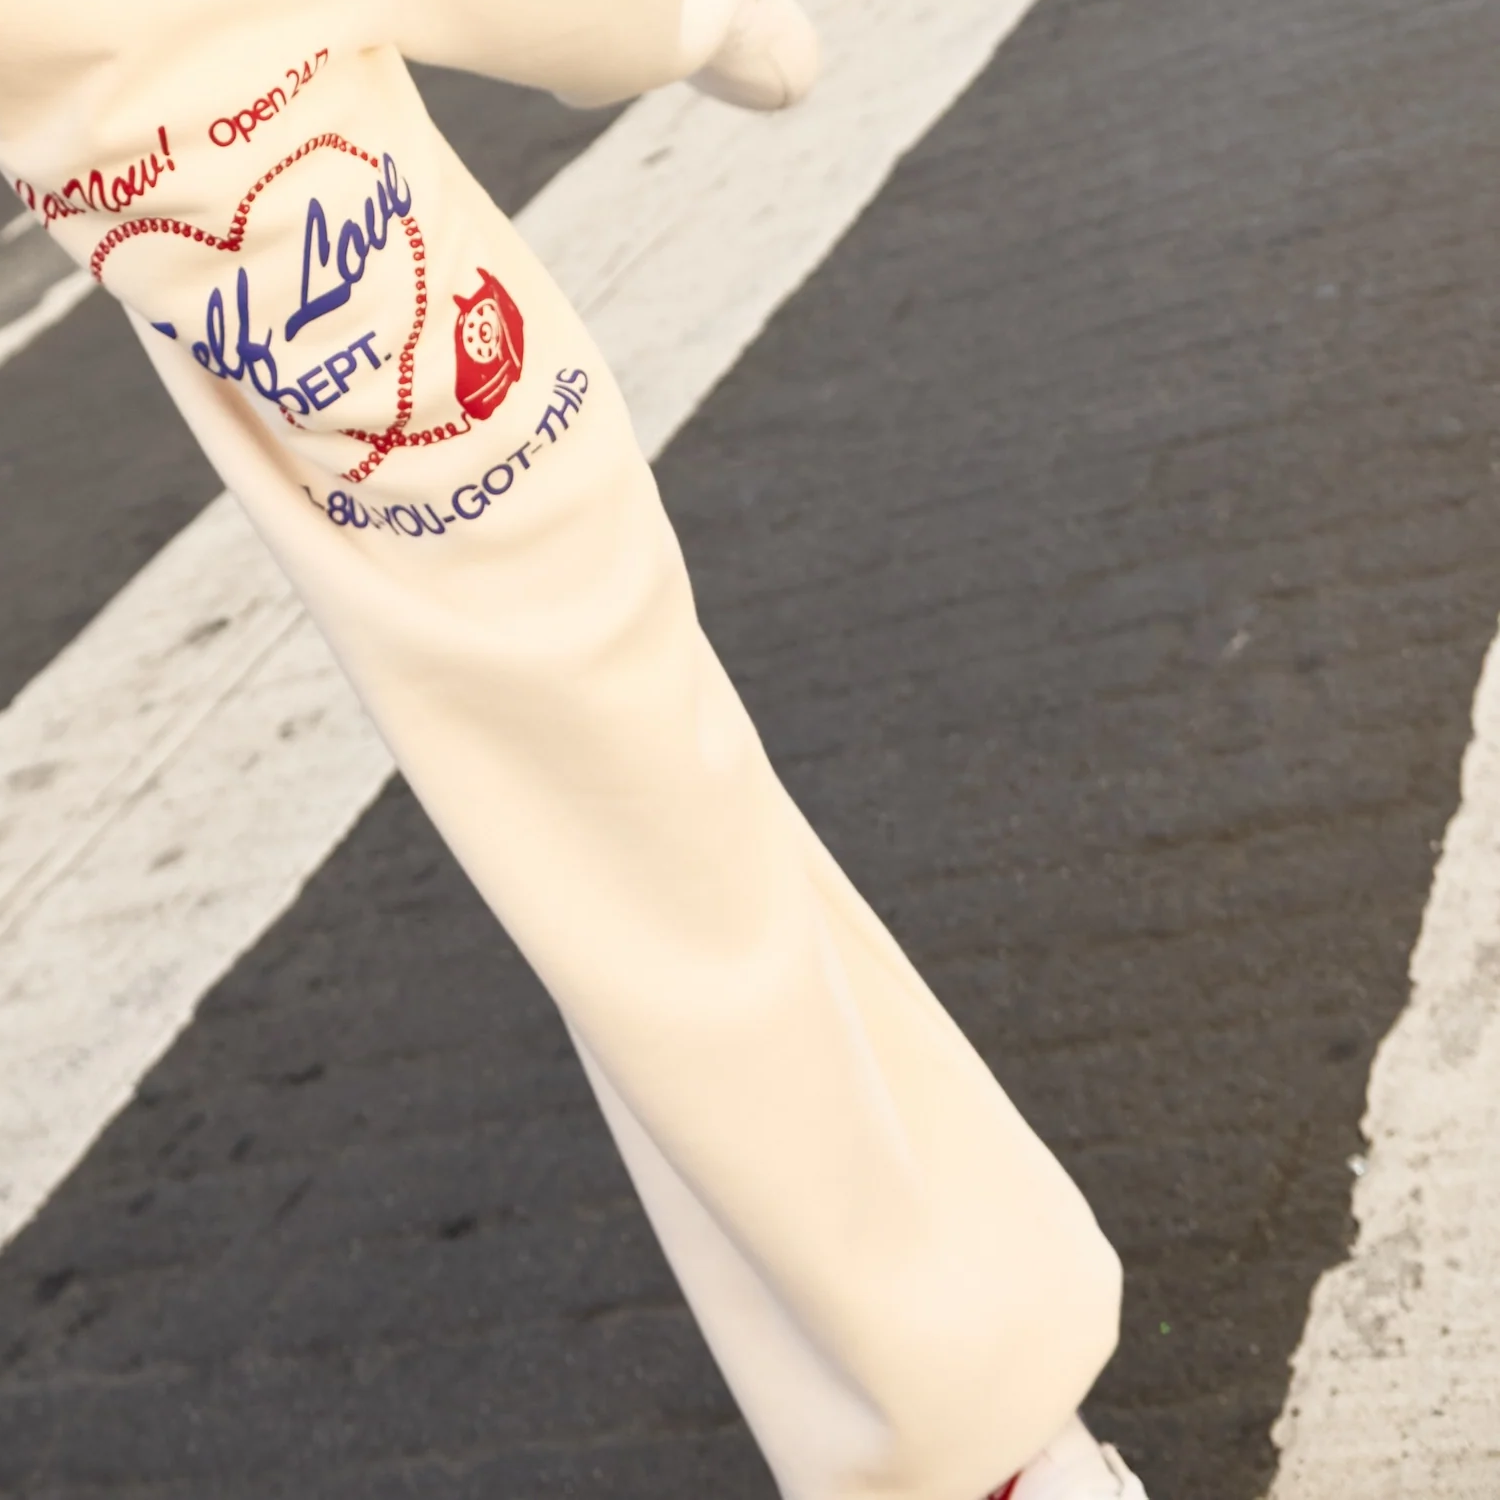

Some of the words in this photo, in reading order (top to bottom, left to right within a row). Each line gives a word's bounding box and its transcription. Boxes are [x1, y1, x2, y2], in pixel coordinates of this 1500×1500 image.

[208, 86, 288, 148] Open
[151, 266, 274, 403] elf
[284, 152, 412, 342] Love
